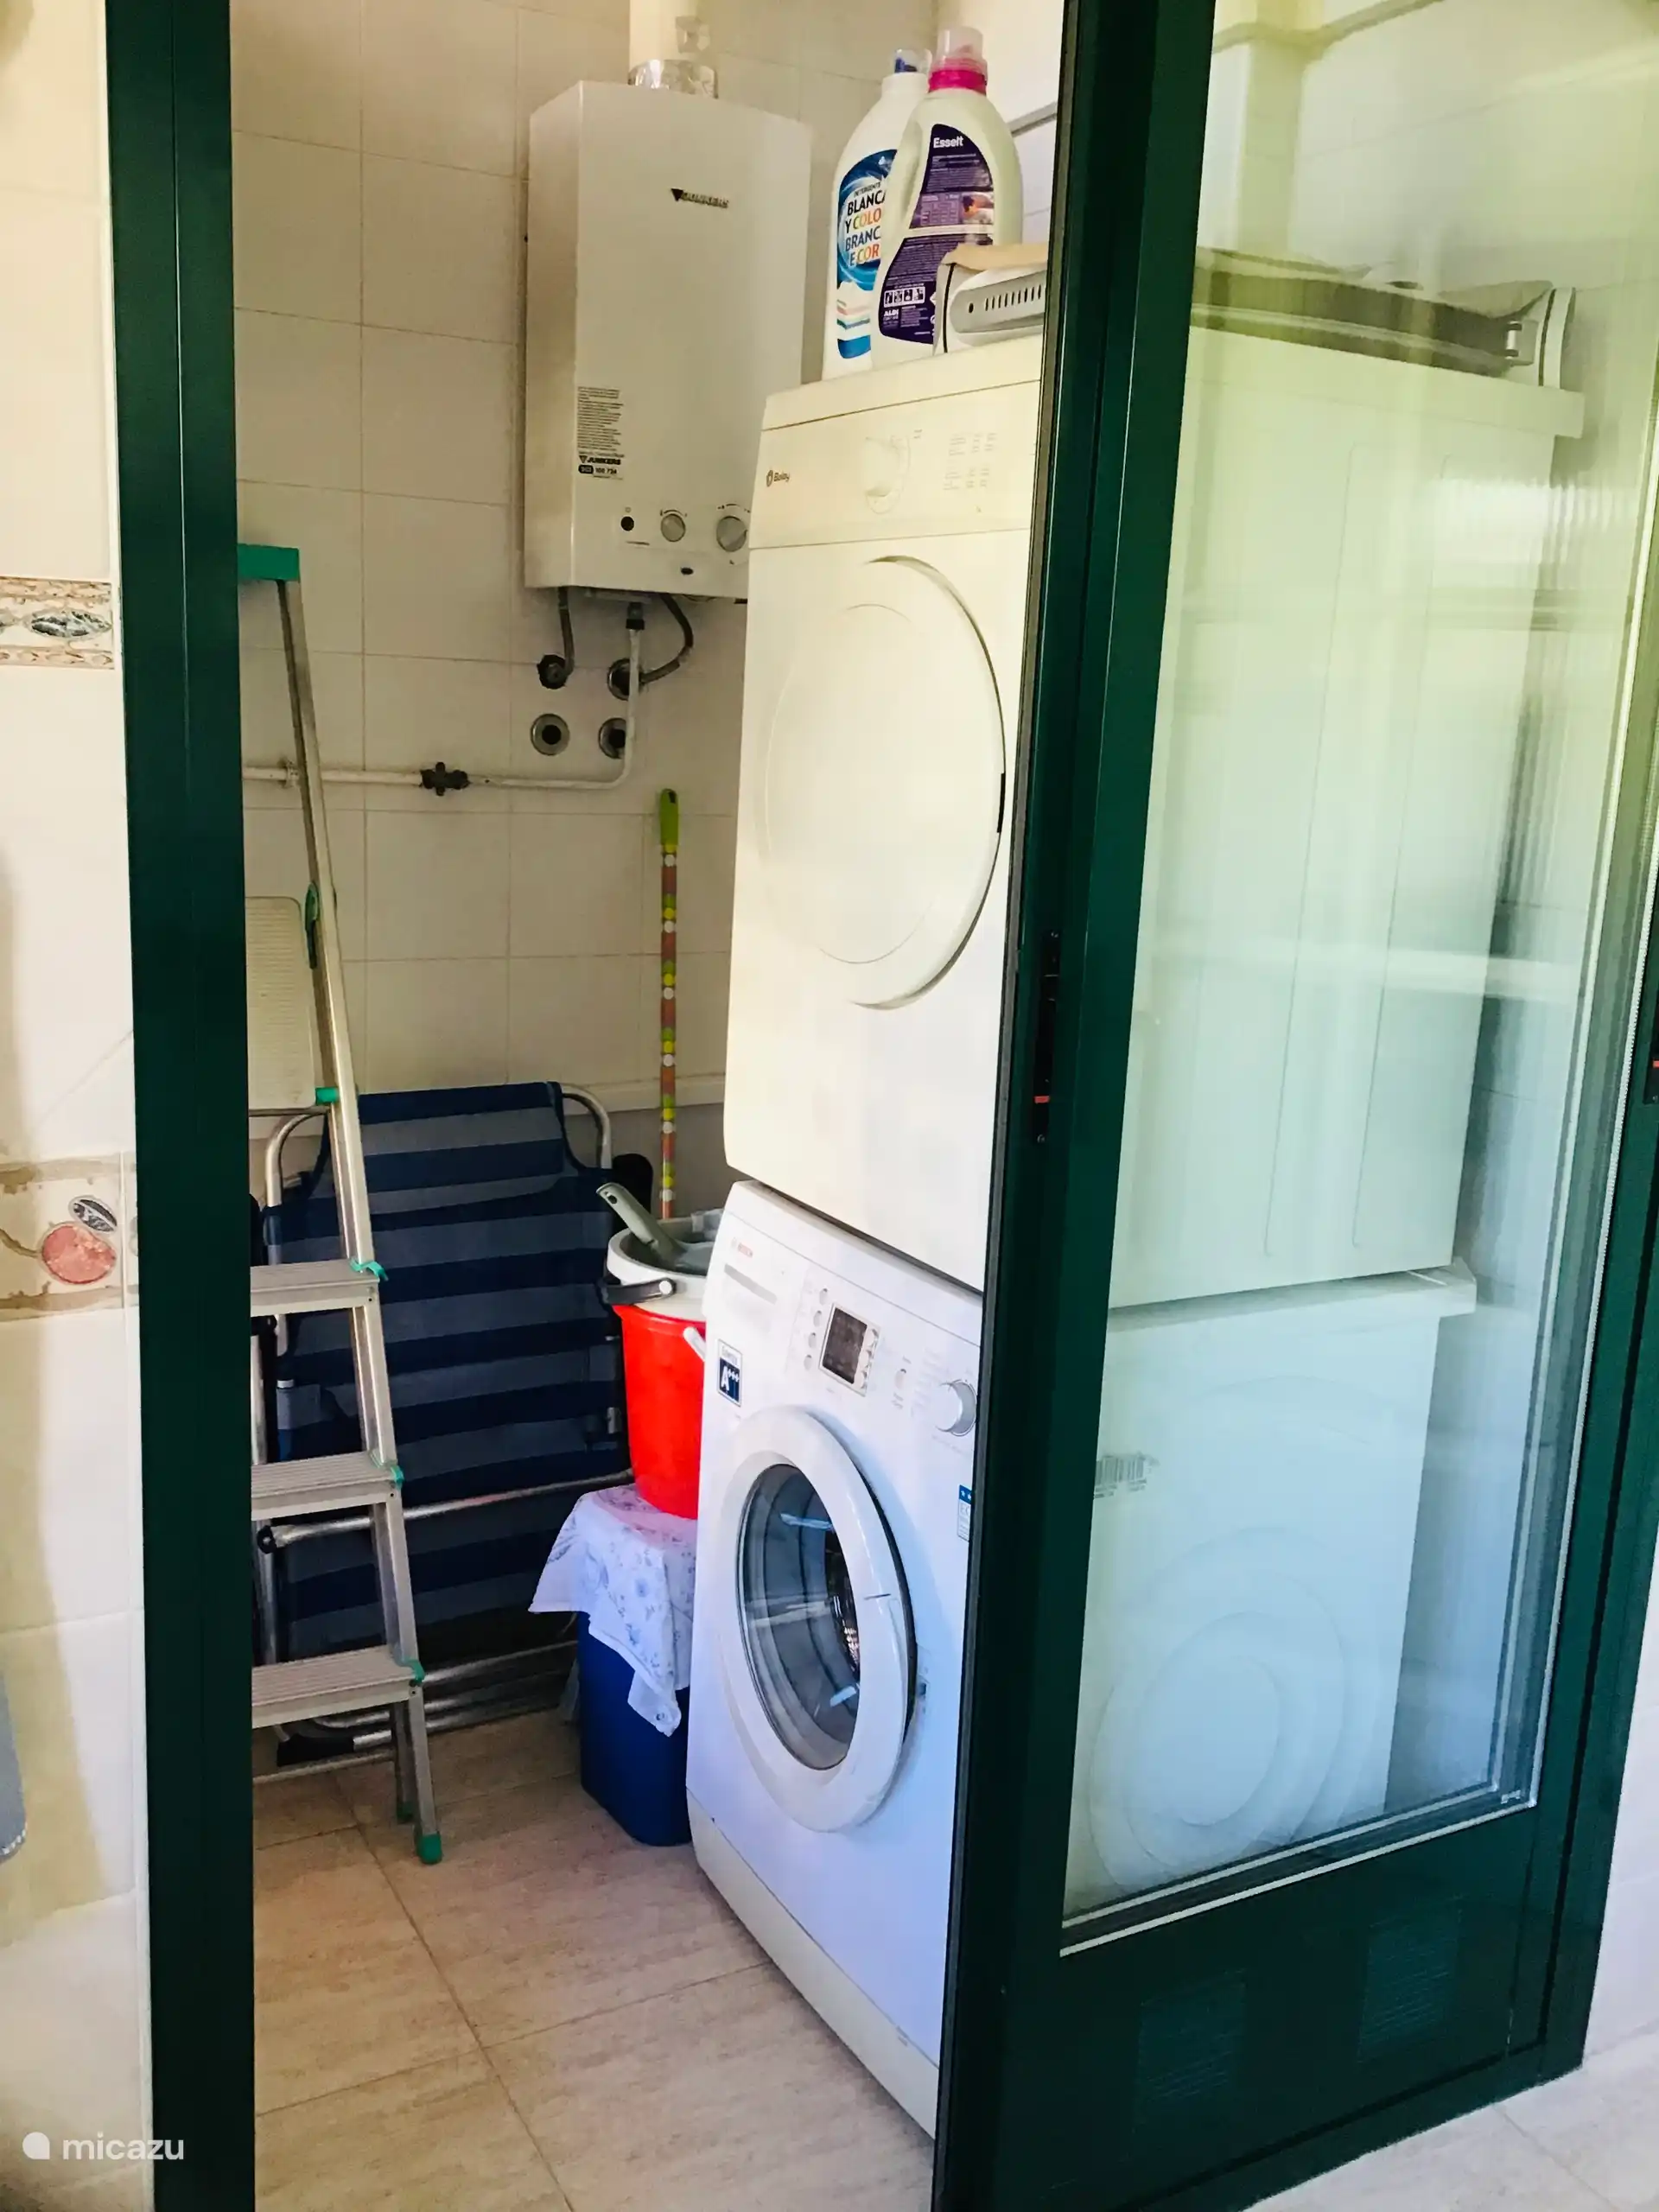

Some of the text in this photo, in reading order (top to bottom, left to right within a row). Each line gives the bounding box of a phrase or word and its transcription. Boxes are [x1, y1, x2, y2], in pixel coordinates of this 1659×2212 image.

[845, 207, 882, 234] Y COLO
[845, 225, 881, 252] BRANC
